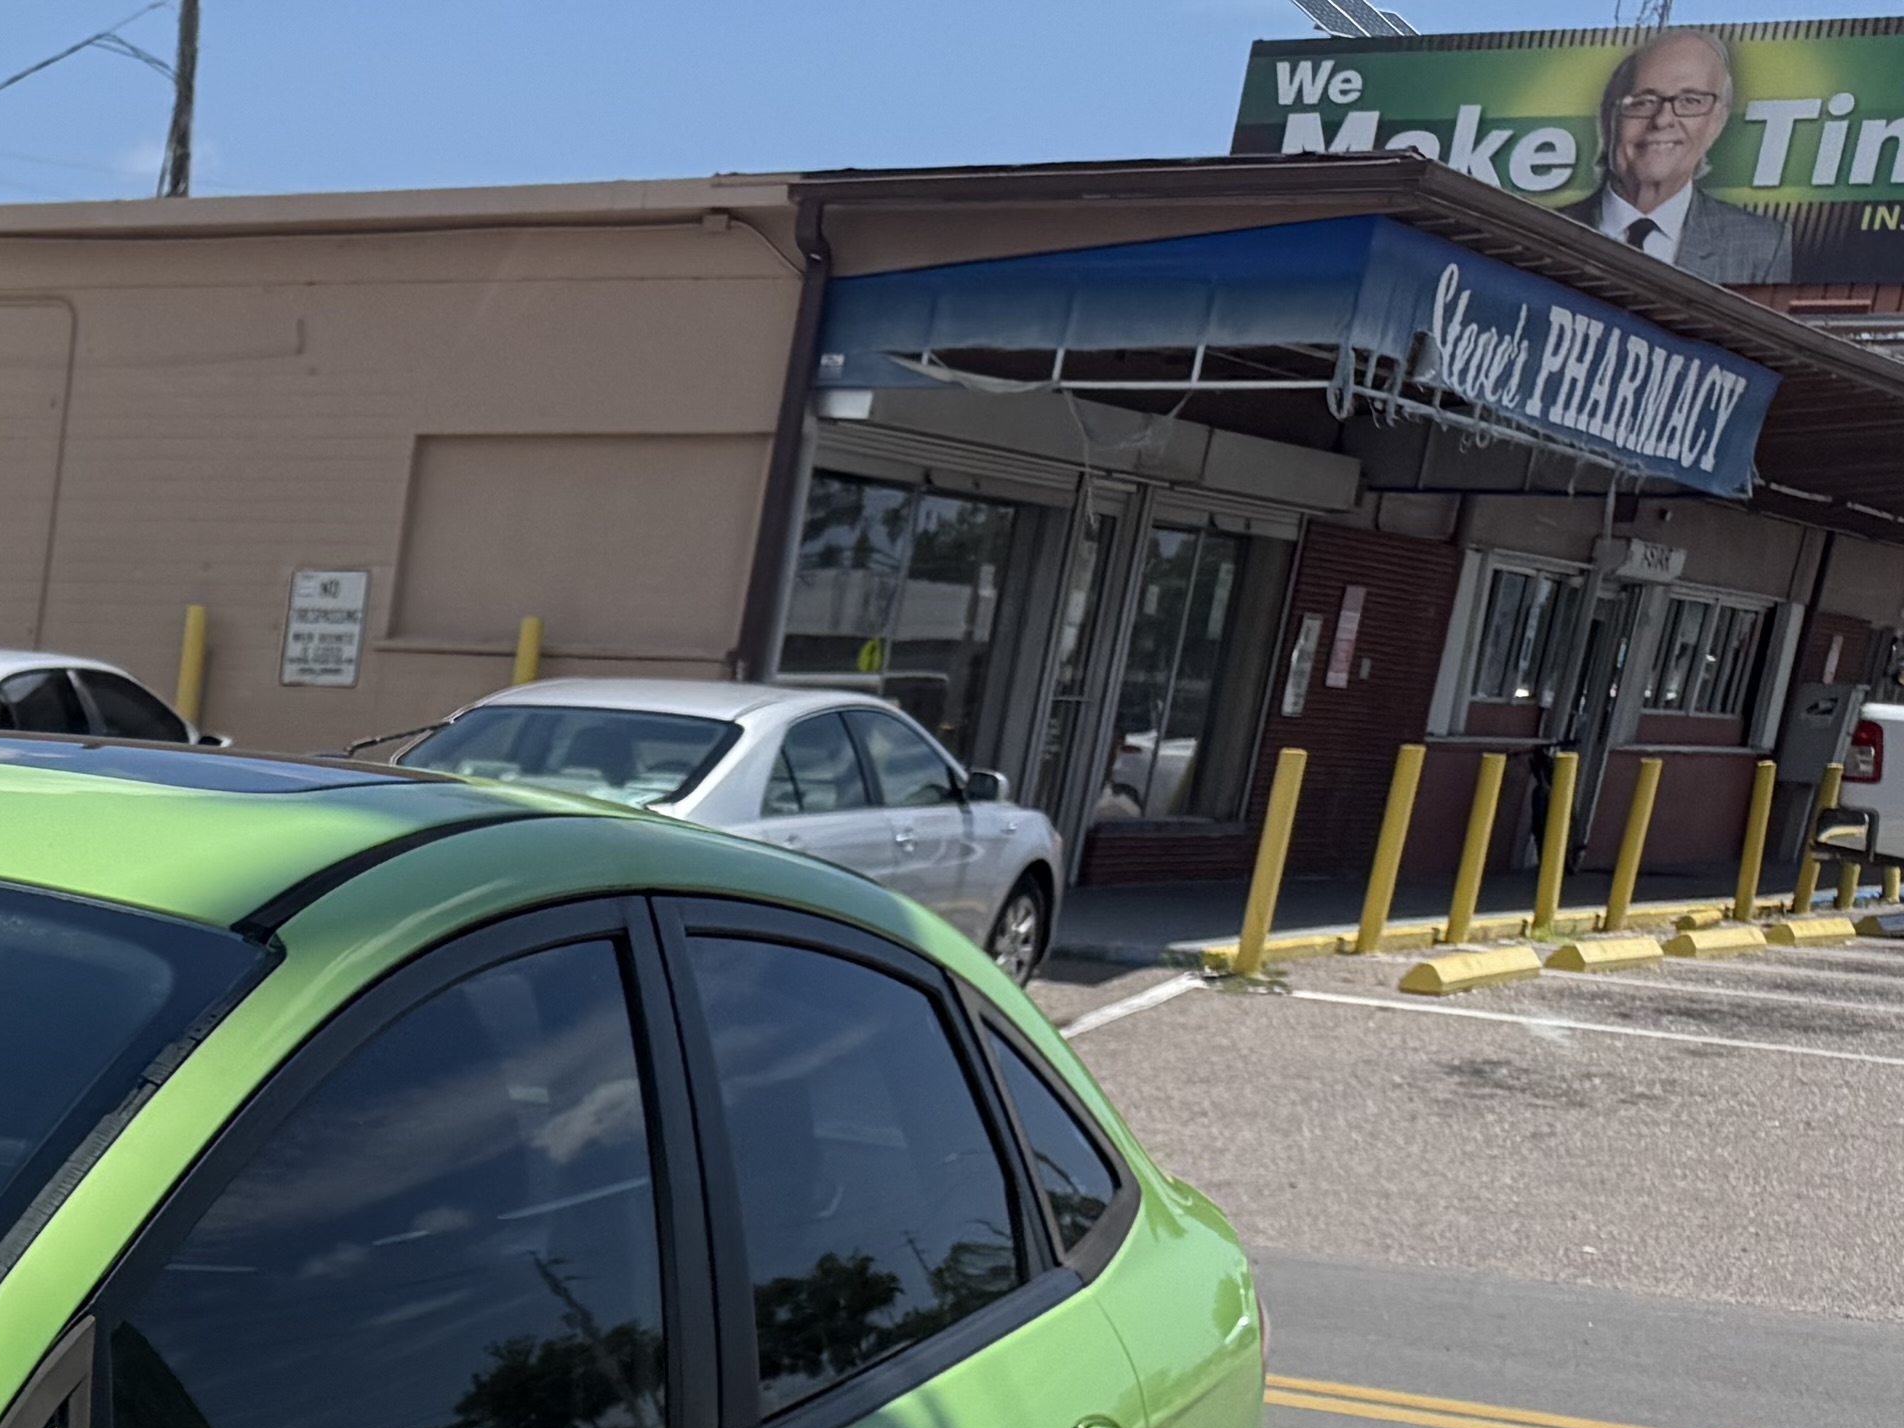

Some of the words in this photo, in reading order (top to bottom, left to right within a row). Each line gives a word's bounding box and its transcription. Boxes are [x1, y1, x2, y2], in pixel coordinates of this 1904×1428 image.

[1276, 59, 1363, 105] We
[1432, 262, 1530, 408] Steve's
[1525, 304, 1747, 473] PHARMACY
